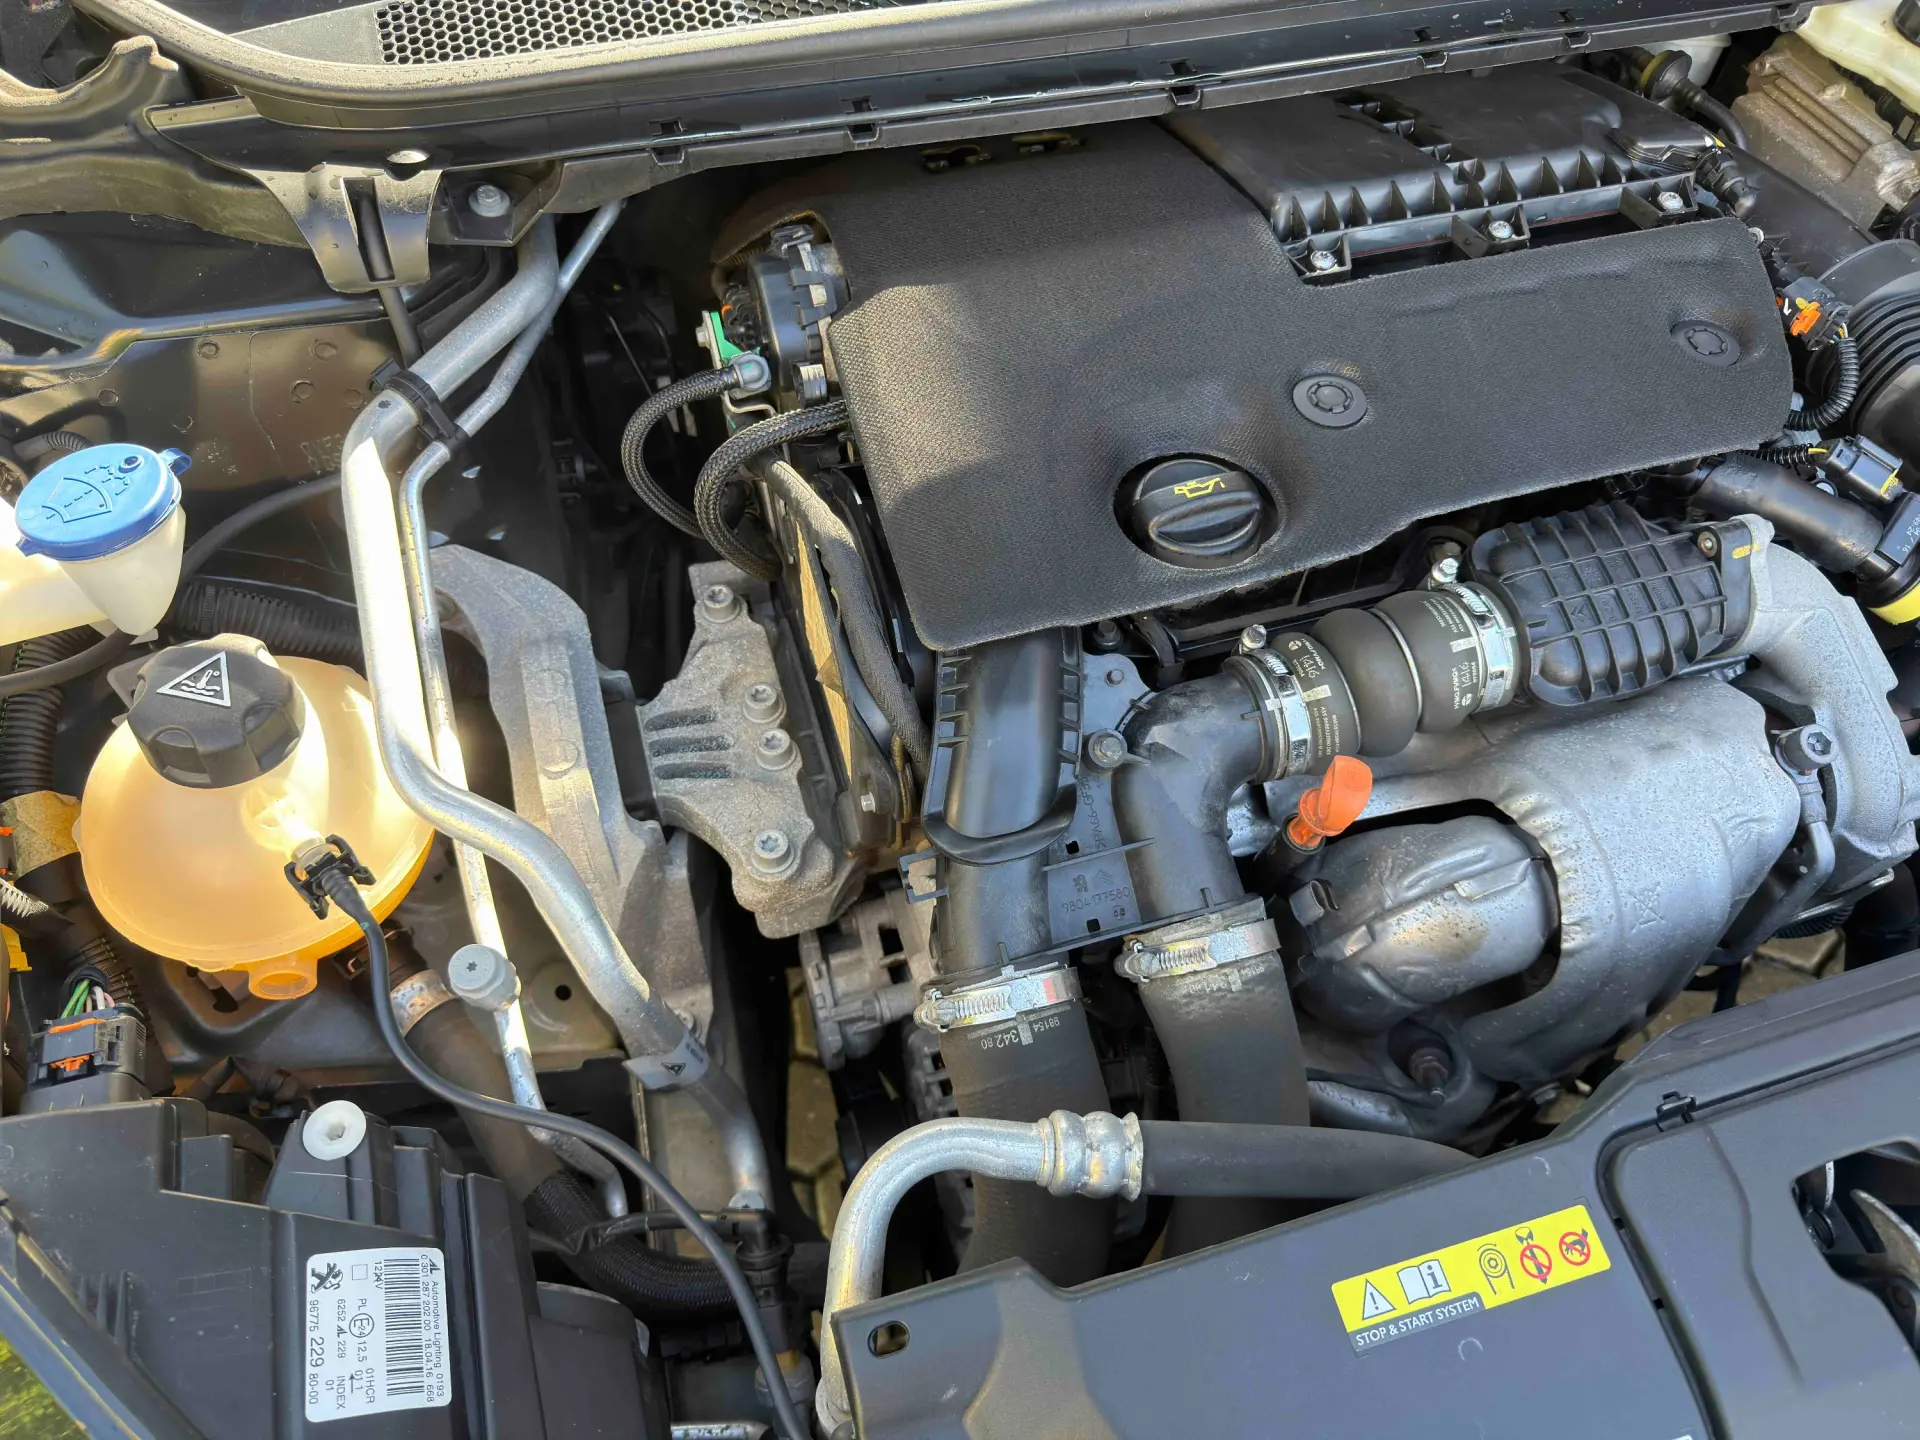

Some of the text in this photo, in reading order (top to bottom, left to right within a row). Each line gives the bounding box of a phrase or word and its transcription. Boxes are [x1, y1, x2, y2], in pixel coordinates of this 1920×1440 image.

[981, 1017, 1060, 1049] 98154 342 80
[357, 1298, 367, 1311] PL
[422, 1282, 430, 1298] 287
[431, 1281, 440, 1330] Automotive
[337, 1299, 346, 1322] 6252
[423, 1301, 431, 1319] 202
[1356, 1297, 1480, 1346] STOP & START SYSTEM
[308, 1299, 325, 1405] 96775 229 80-00
[337, 1341, 347, 1359] 229
[424, 1338, 434, 1377] 18.04.16
[433, 1333, 441, 1368] Lighting
[336, 1375, 346, 1410] INDEX
[365, 1368, 376, 1404] 01HCR
[436, 1374, 445, 1397] 0193
